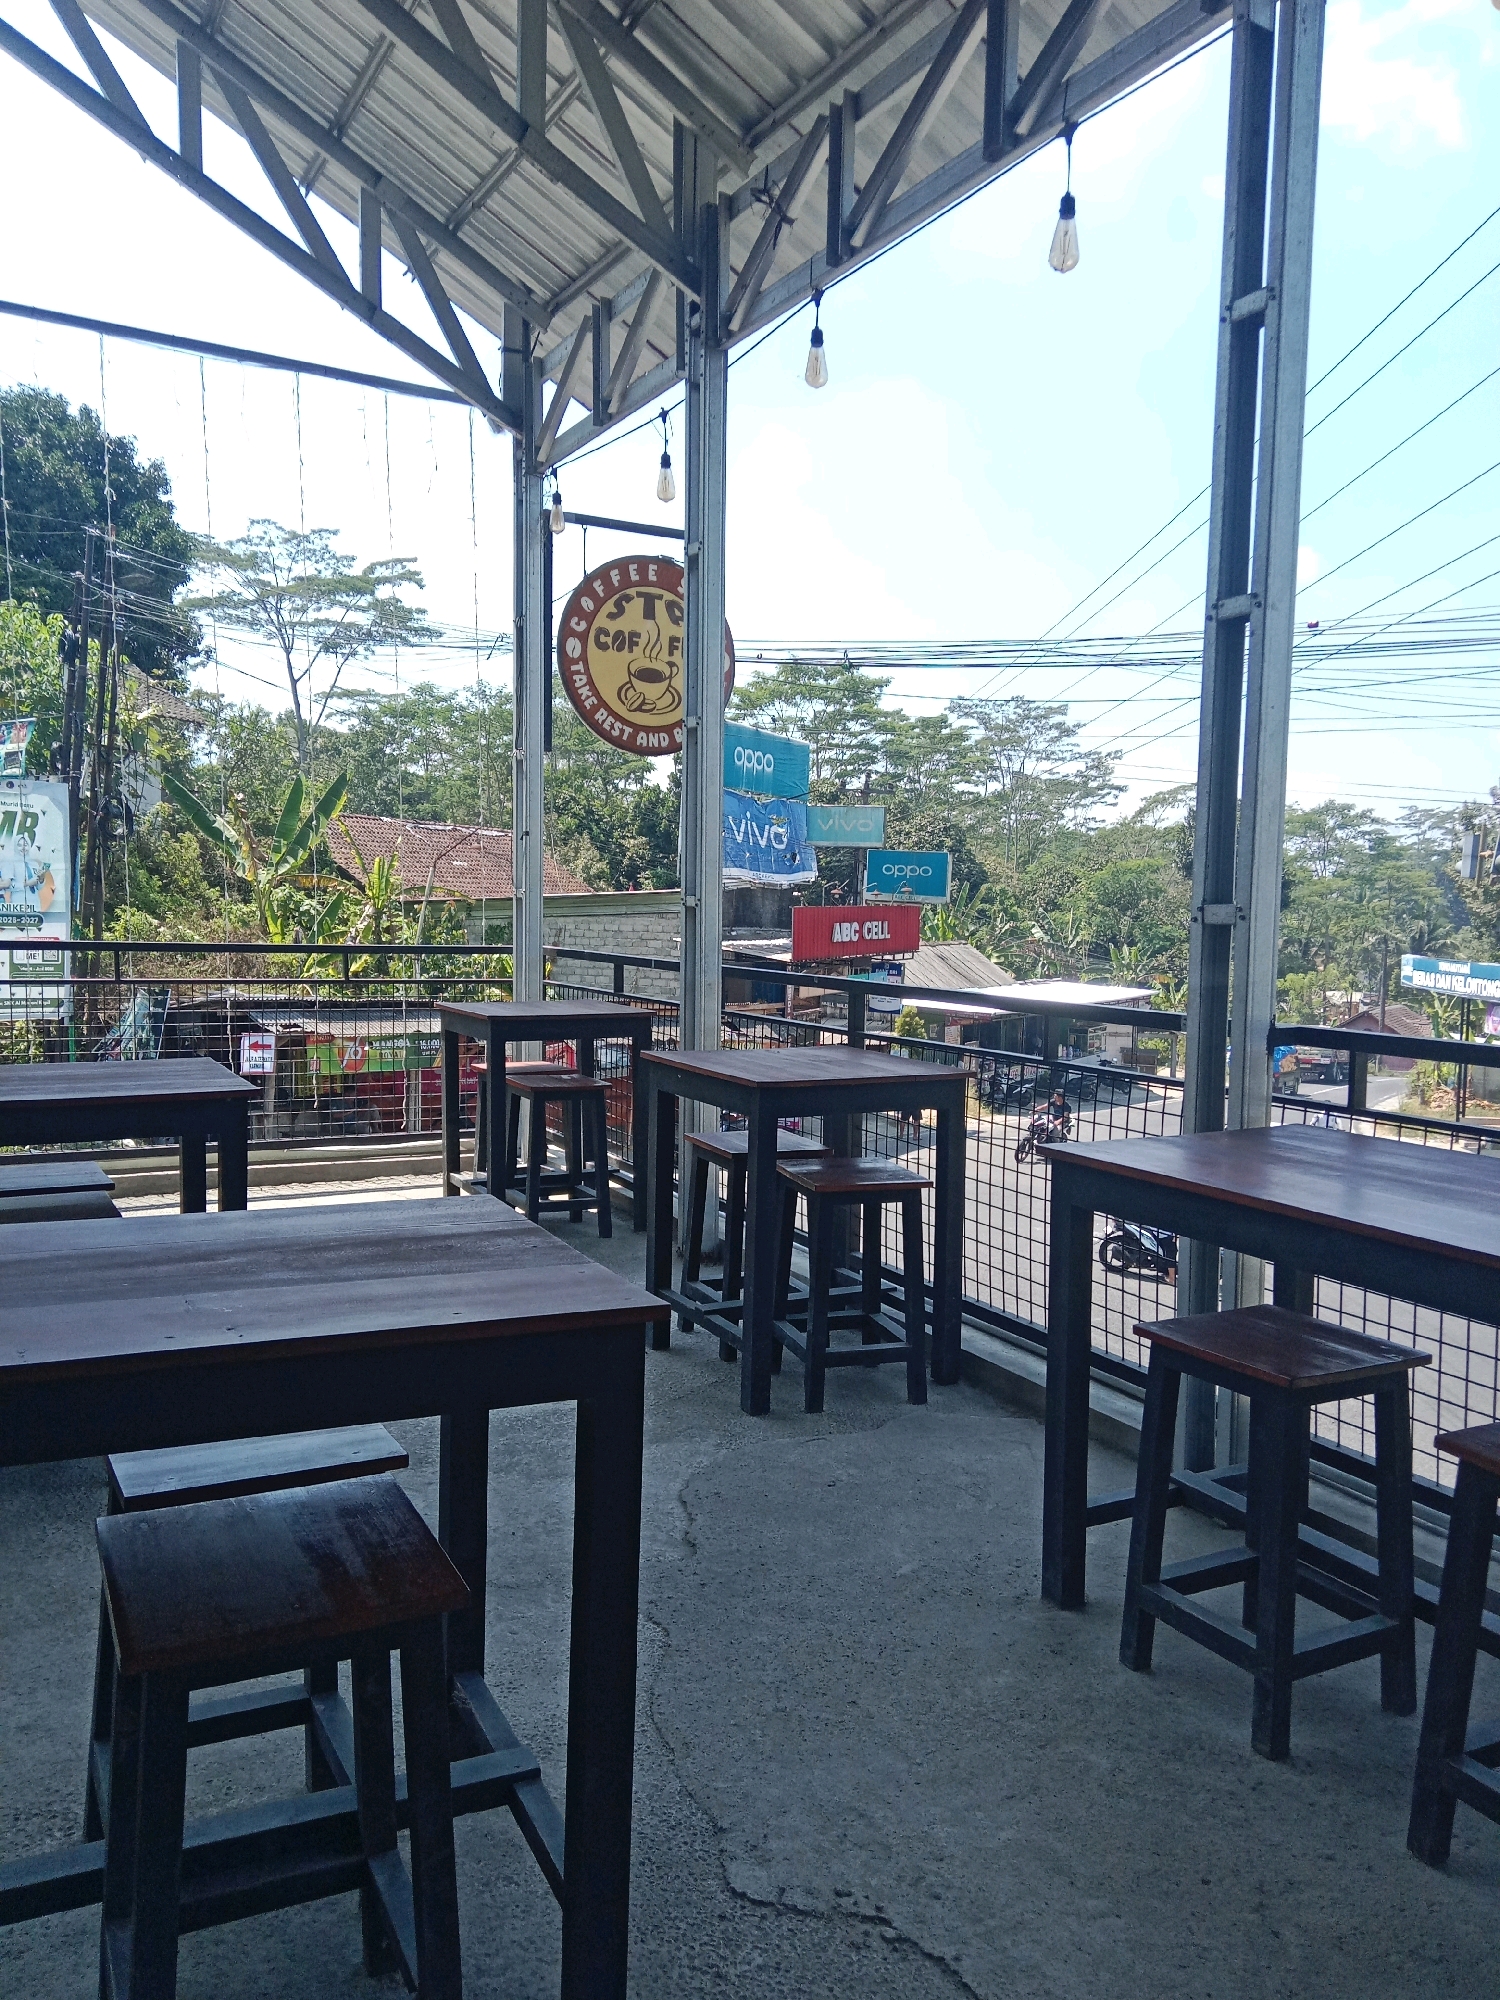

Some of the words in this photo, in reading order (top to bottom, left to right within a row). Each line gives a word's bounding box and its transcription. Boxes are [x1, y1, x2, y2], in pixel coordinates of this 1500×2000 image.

[570, 563, 658, 632] COFFEE
[570, 661, 598, 710] TAKE
[594, 708, 633, 741] REST
[636, 731, 670, 748] AND
[734, 746, 774, 776] oppo
[728, 811, 788, 849] vivo
[818, 815, 874, 832] vivo
[882, 864, 932, 878] oppo
[832, 922, 860, 943] ABC
[862, 920, 891, 940] CELL
